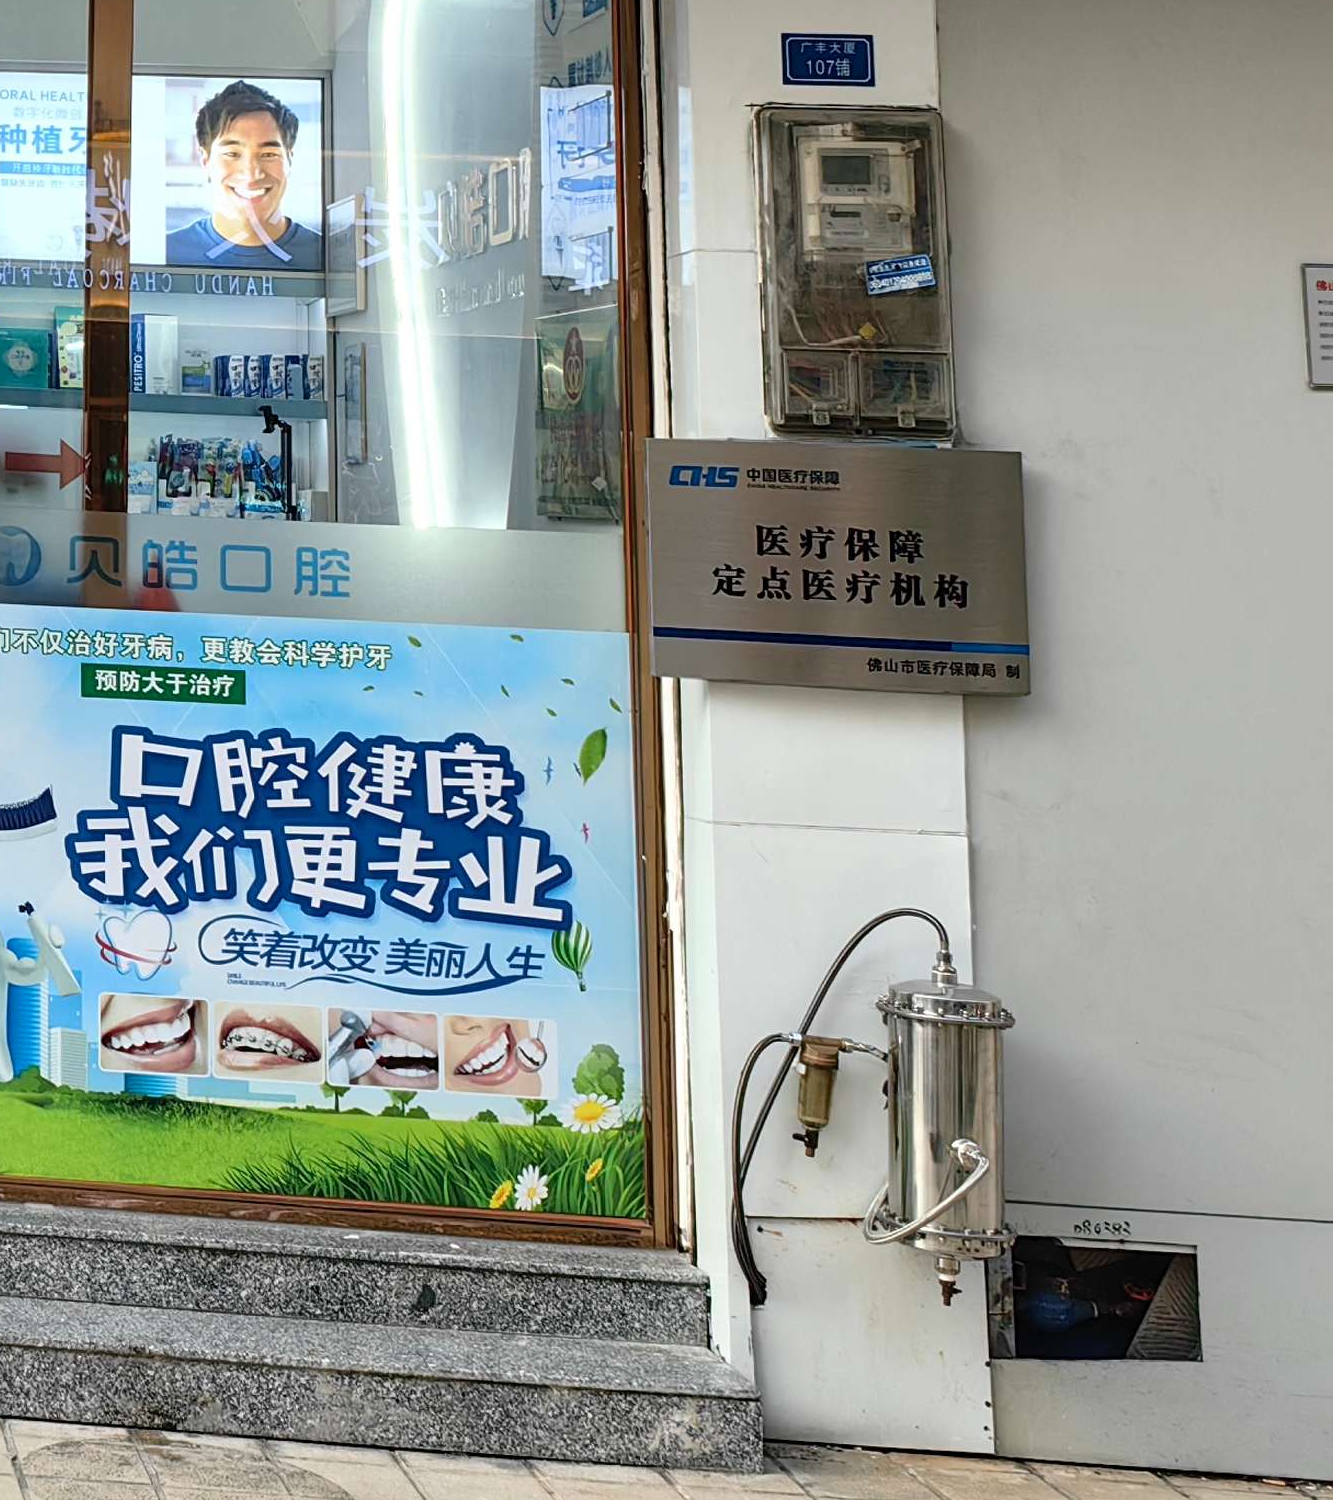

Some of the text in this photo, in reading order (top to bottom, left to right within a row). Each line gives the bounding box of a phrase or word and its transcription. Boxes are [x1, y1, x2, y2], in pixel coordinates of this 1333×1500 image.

[804, 56, 852, 79] 107铺
[0, 89, 85, 102] ORAL HEALT
[746, 467, 840, 485] 中国医疗保障
[755, 523, 925, 564] 医疗保障
[66, 534, 351, 598] 贝皓口腔
[711, 564, 970, 610] 定点医疗机构
[93, 669, 237, 698] 预防大于治疗
[866, 656, 1022, 681] 佛山市医疗保障局 制
[116, 732, 517, 829] 口腔健康
[72, 807, 566, 922] 我们更专业
[221, 925, 547, 982] 笑着改变 美丽人生
